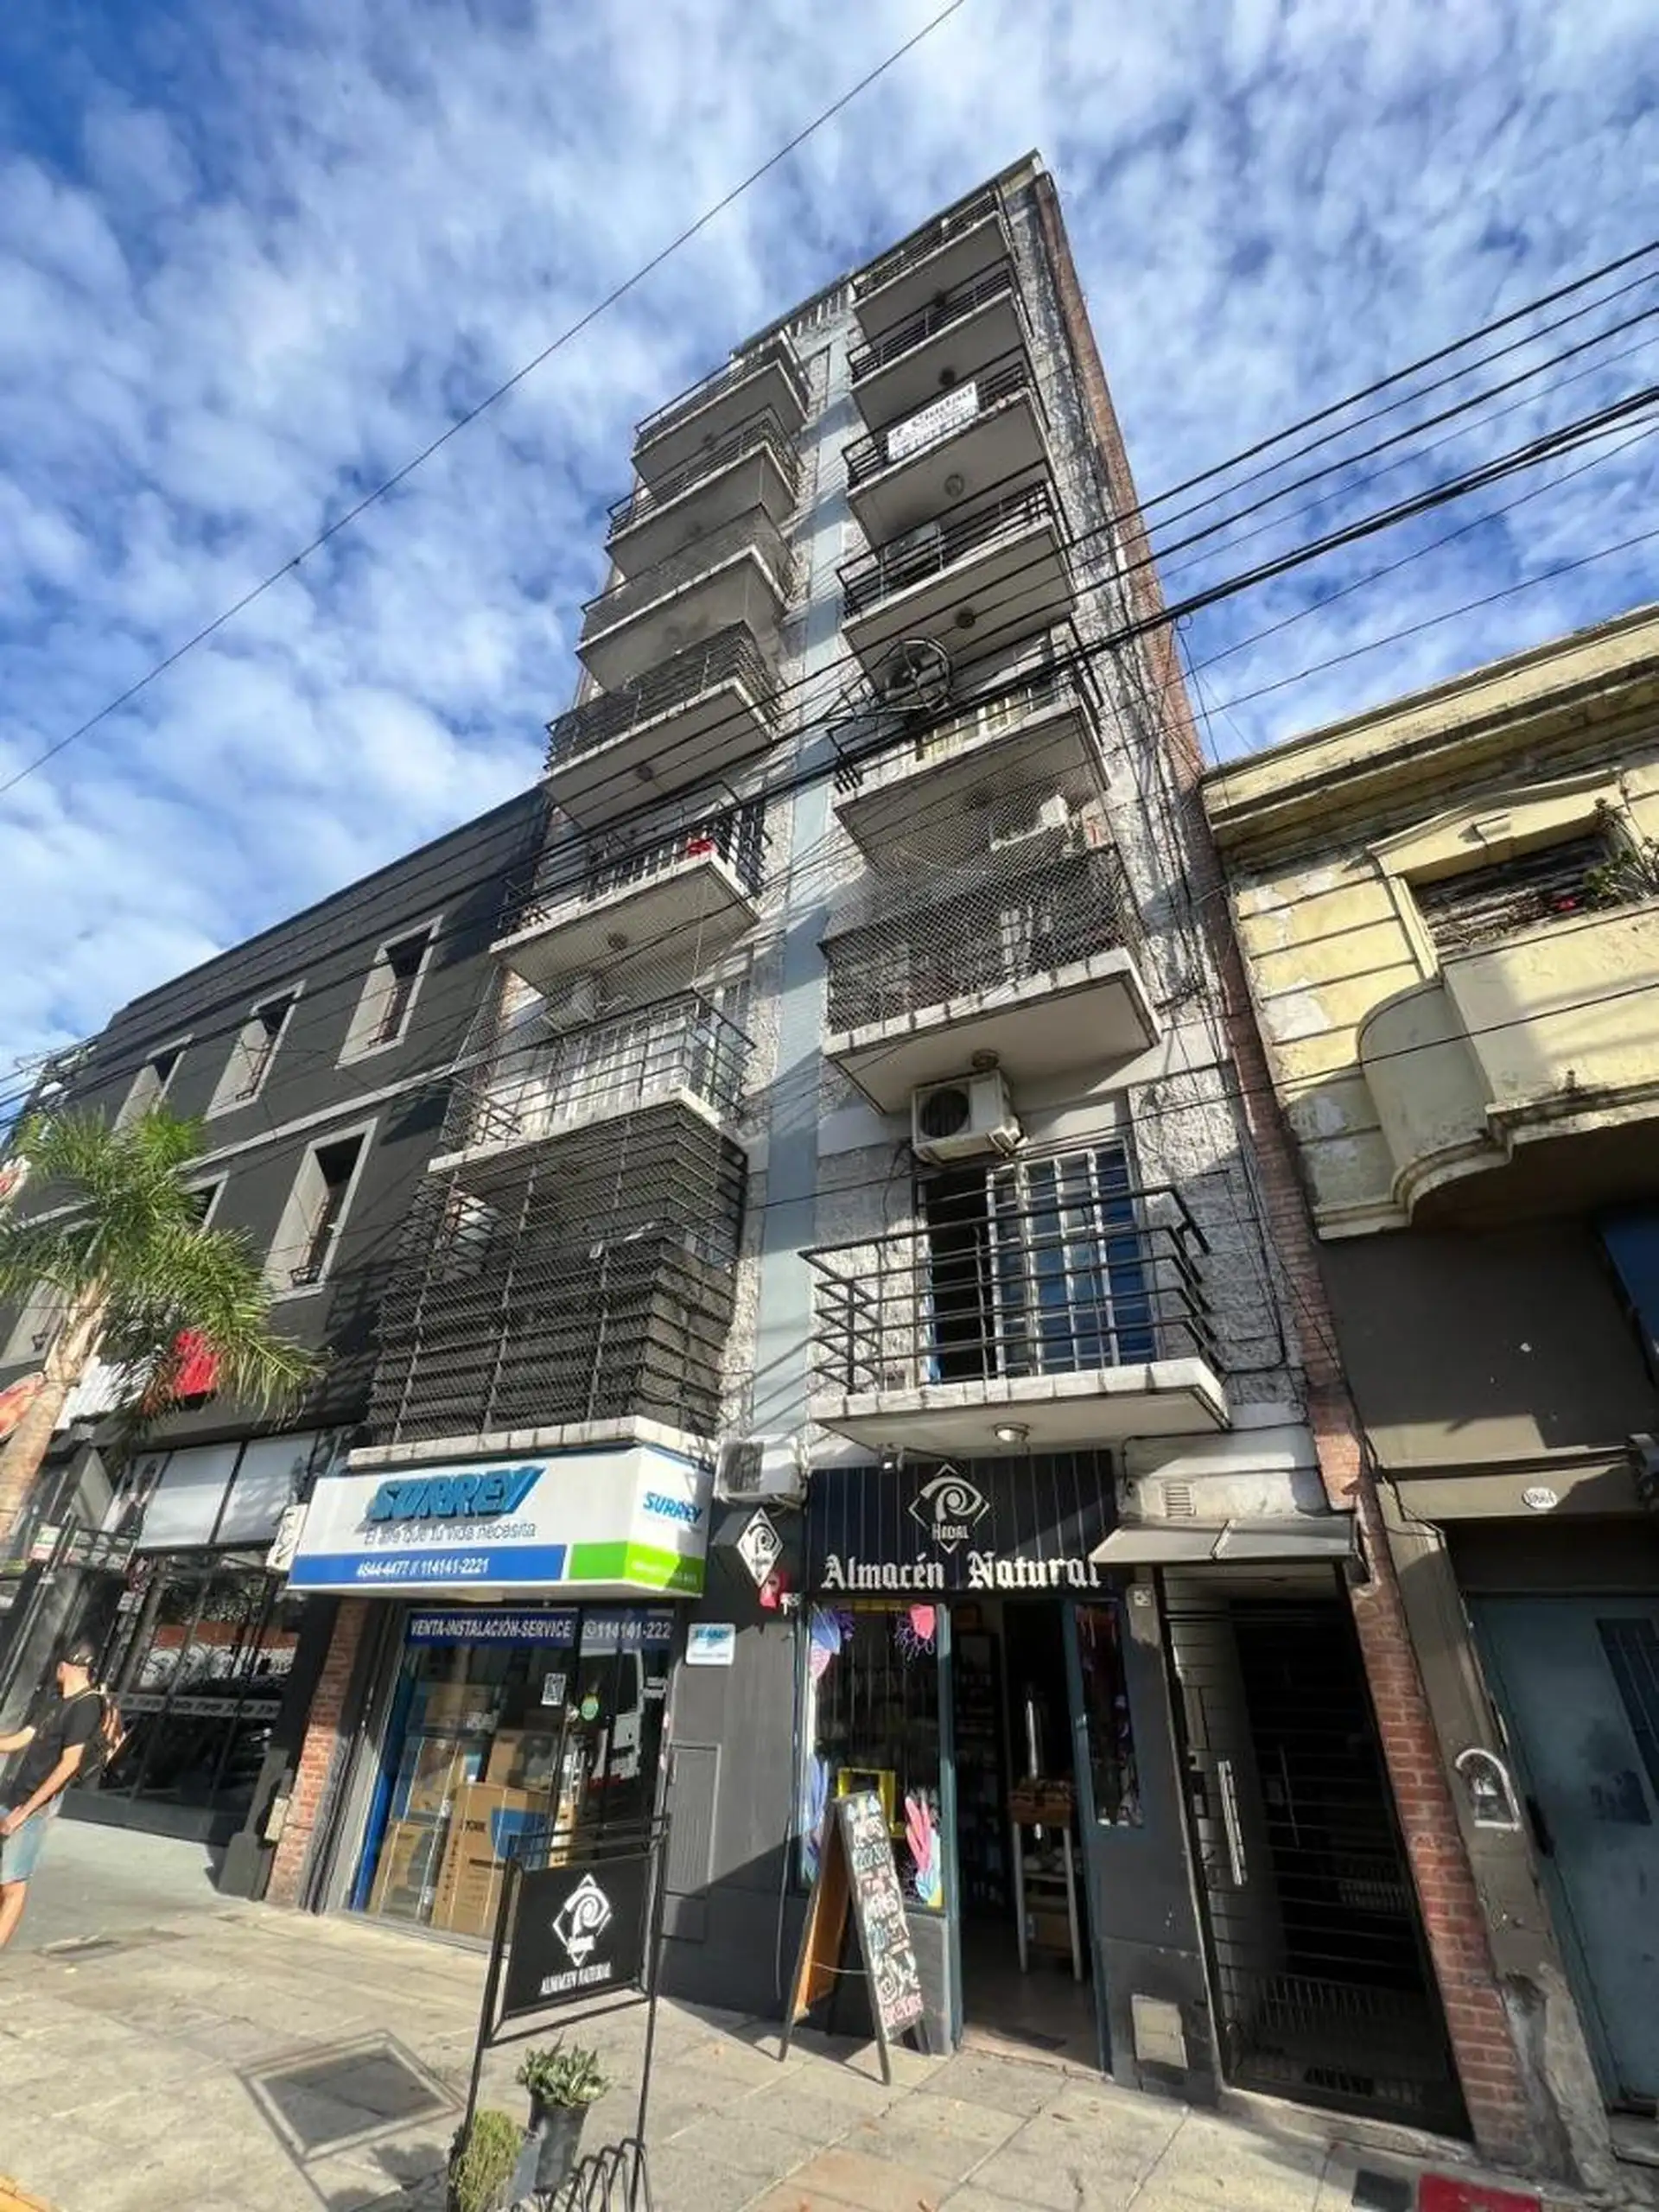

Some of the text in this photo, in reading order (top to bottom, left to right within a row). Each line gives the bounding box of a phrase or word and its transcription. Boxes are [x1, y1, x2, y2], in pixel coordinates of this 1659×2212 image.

[371, 1466, 546, 1522] SURREY
[643, 1491, 702, 1524] SURREY
[821, 1551, 1101, 1590] Almacén Natural
